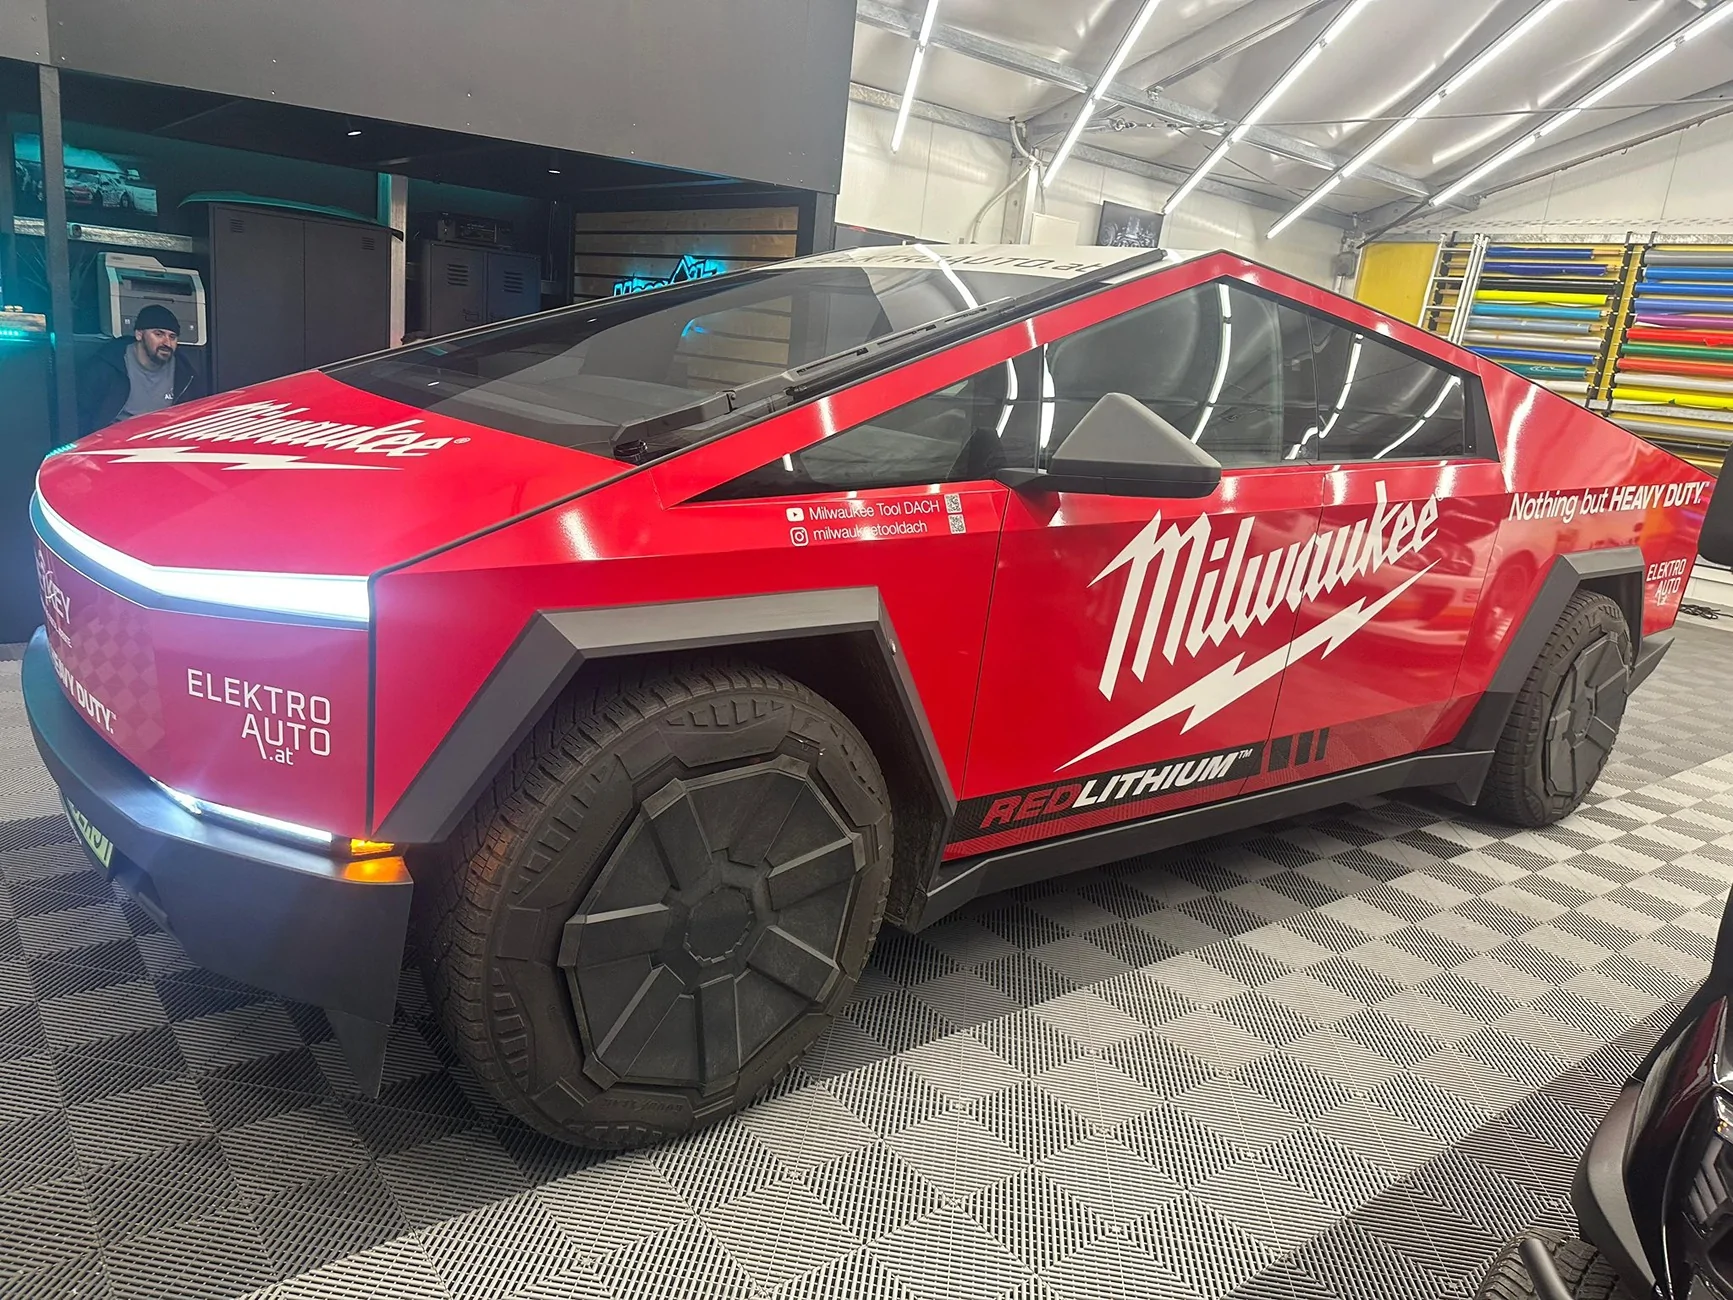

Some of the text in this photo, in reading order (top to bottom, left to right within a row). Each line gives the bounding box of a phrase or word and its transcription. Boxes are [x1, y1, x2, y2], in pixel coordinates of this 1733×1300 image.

[809, 500, 940, 521] Milwaukee Tool DACH
[1508, 489, 1577, 524] Nothing
[1580, 487, 1610, 515] but
[1609, 484, 1666, 512] HEAVY
[1646, 558, 1687, 582] ELEKTRO
[1655, 577, 1681, 606] AUTO
[187, 668, 331, 725] ELEKTRO
[241, 713, 331, 760] AUTO
[269, 747, 294, 765] .at
